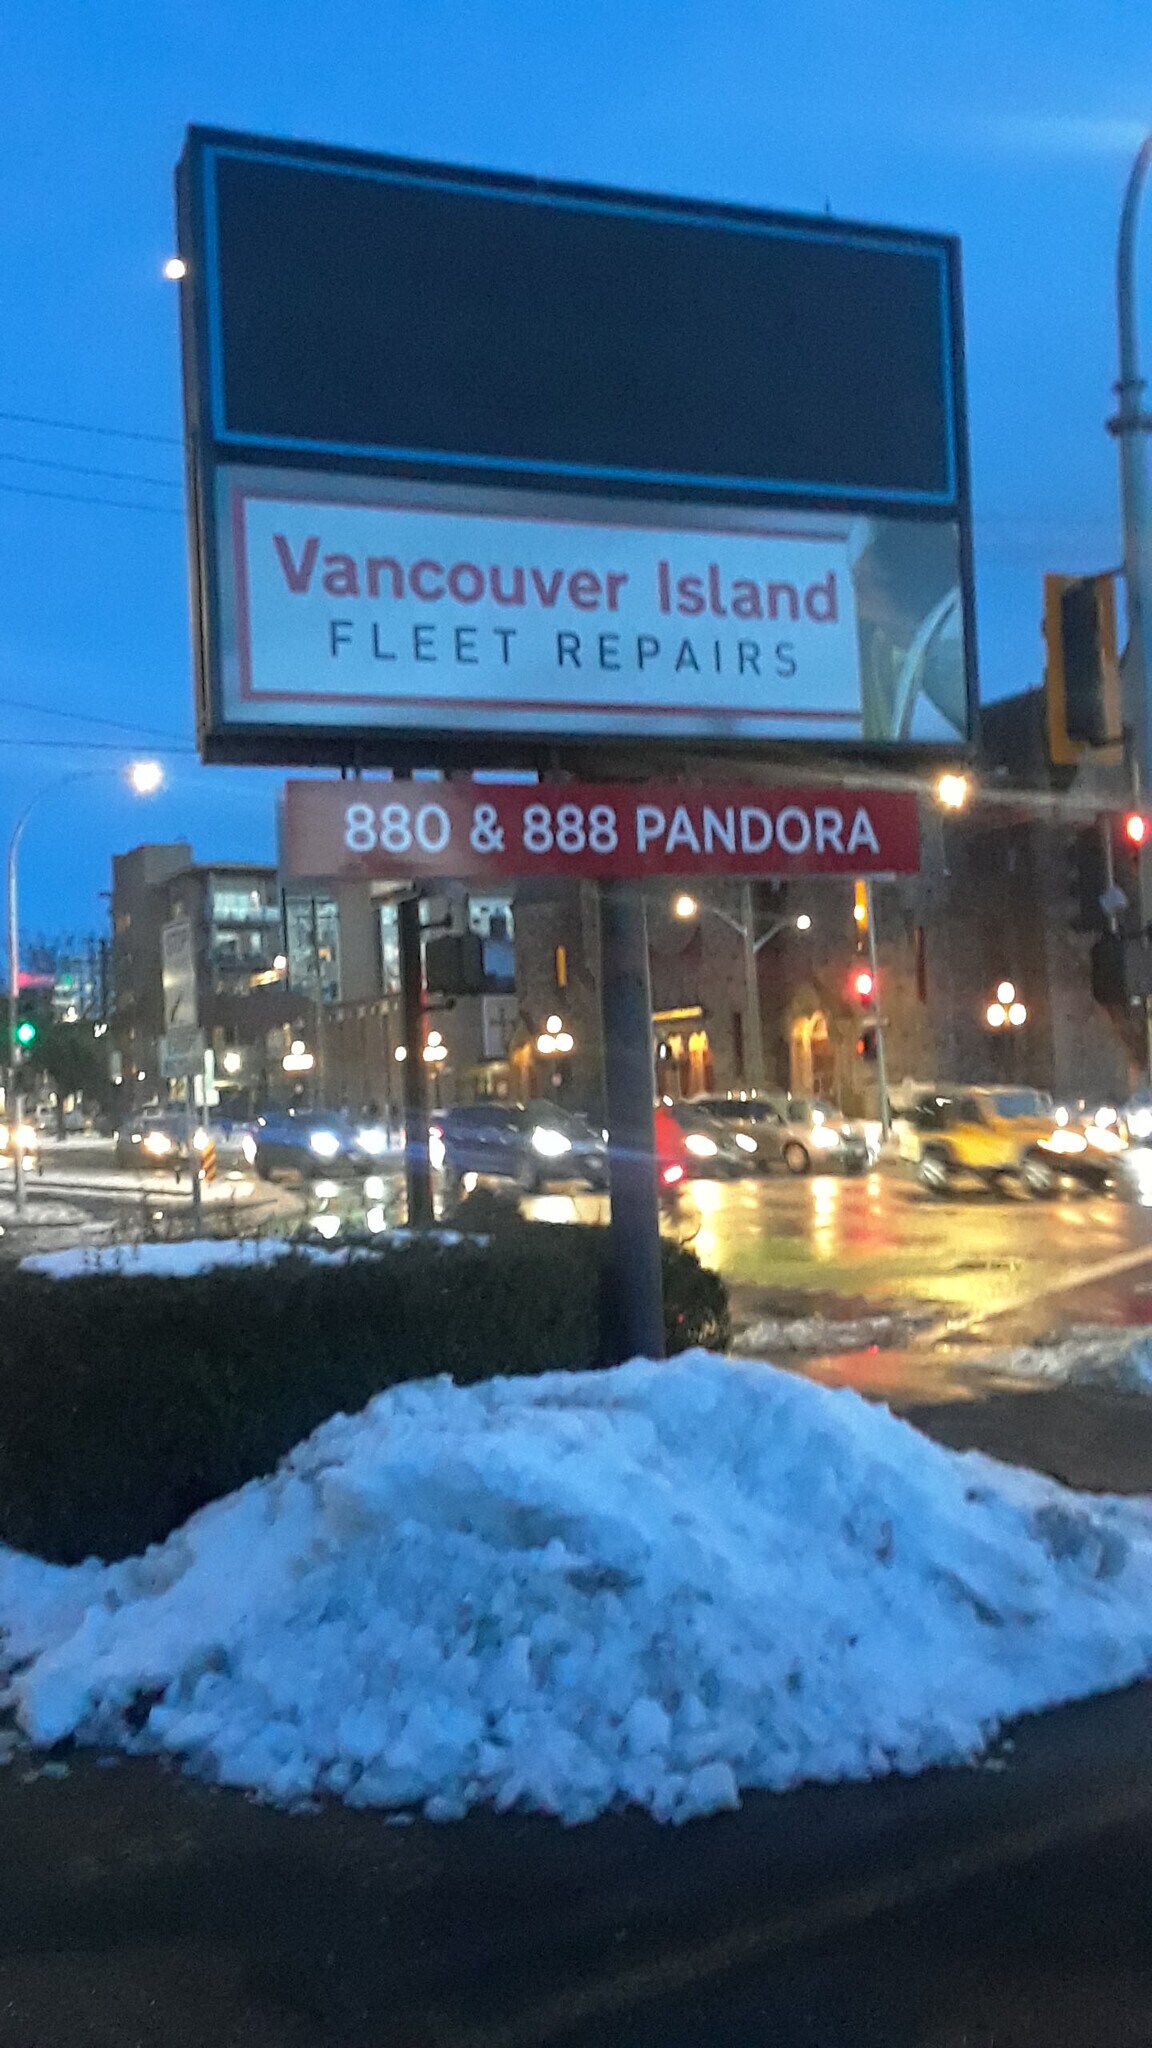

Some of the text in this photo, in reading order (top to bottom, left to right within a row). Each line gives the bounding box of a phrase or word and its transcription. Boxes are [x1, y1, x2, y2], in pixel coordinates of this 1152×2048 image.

[273, 534, 839, 623] Vancouver Island
[330, 620, 798, 678] FLEET REPAIRS
[344, 802, 880, 856] 880 & 888 PANDORA
